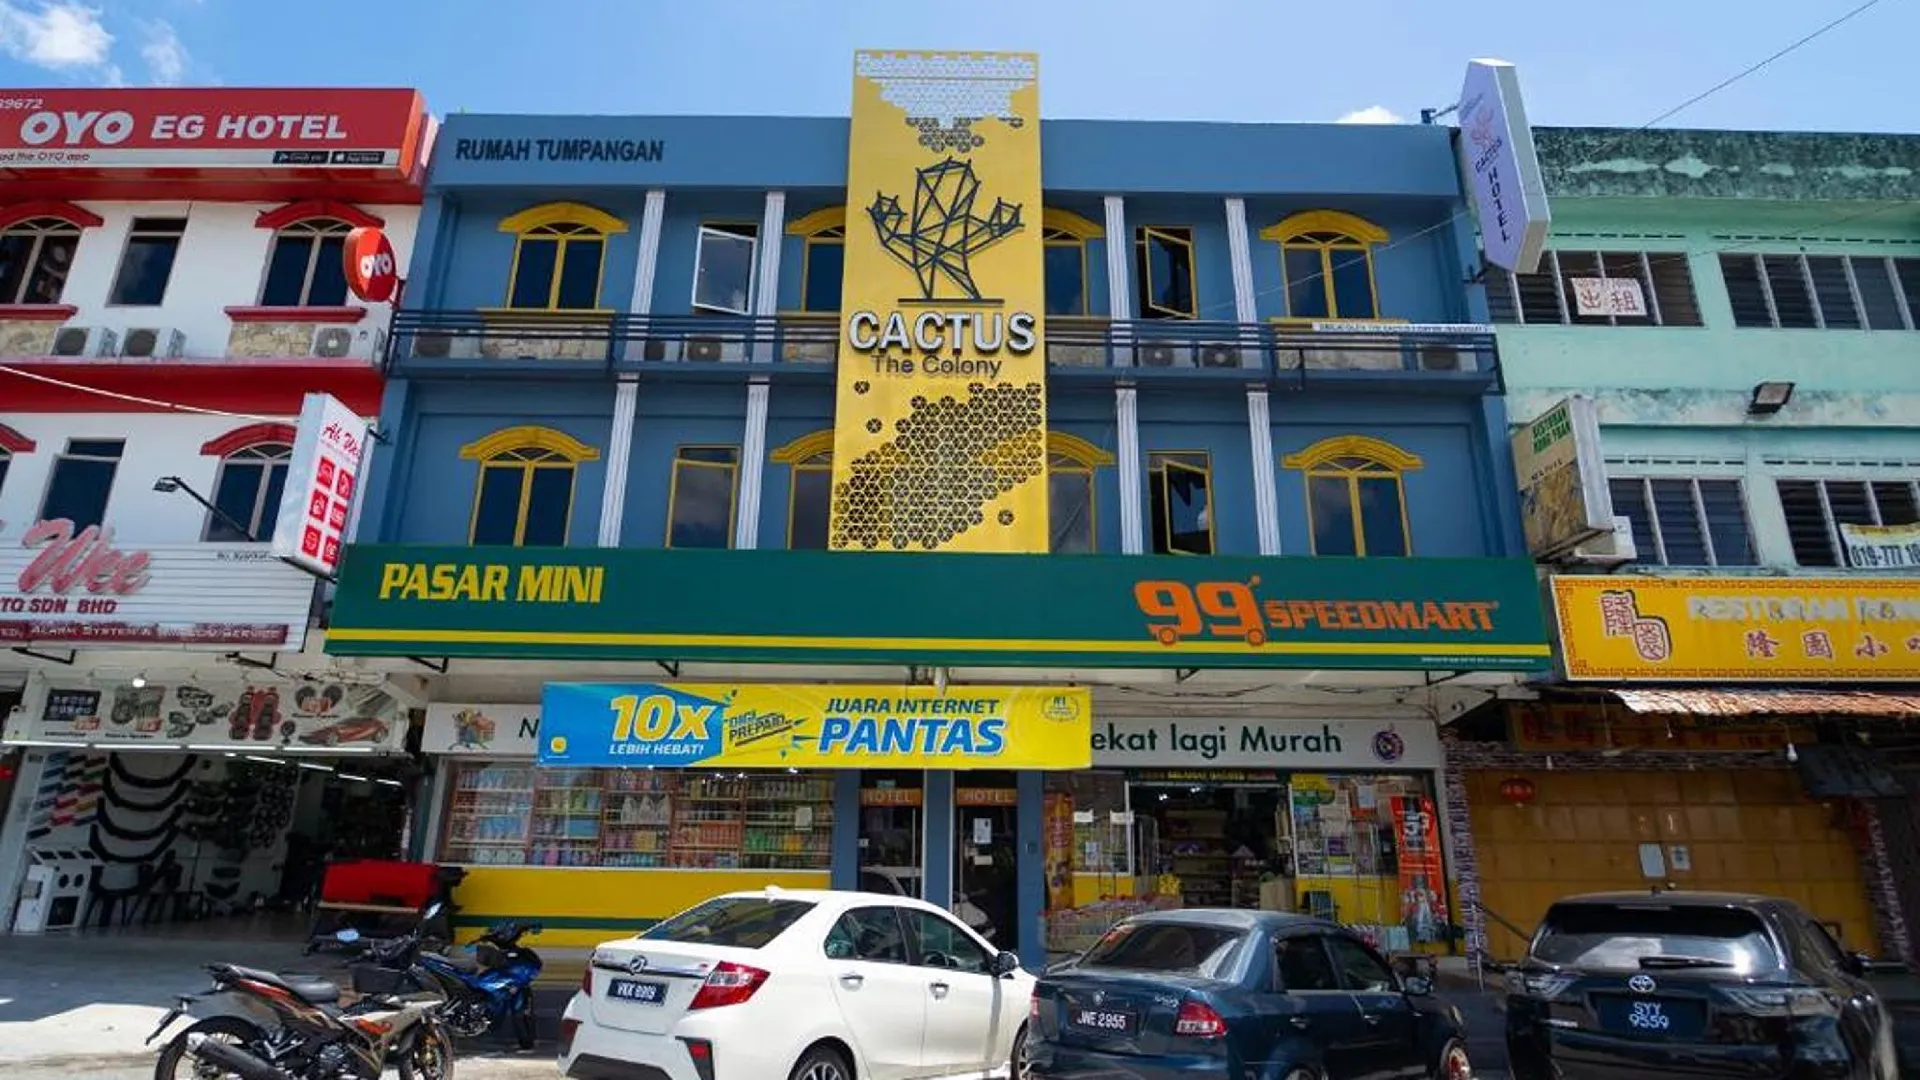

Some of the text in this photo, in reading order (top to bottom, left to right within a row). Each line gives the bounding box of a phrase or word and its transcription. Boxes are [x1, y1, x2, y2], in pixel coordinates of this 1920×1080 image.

[21, 111, 347, 144] OYO EG HOTEL
[456, 138, 664, 162] RUMAH TUMPANGAN
[361, 253, 392, 279] OYO
[850, 311, 1037, 355] CACTUS
[872, 354, 1002, 379] The Colony
[379, 563, 604, 603] PASAR MINI
[28, 598, 67, 613] SDN
[77, 599, 118, 614] BHD
[1133, 576, 1495, 647] 99 SPEEDMART
[611, 695, 717, 741] 10x
[826, 698, 999, 714] JUARA INTERNET
[609, 743, 704, 756] LEBIH HEBAT!
[818, 716, 1007, 755] PANTAS
[1171, 724, 1226, 759] lagi
[1240, 725, 1342, 753] Murah
